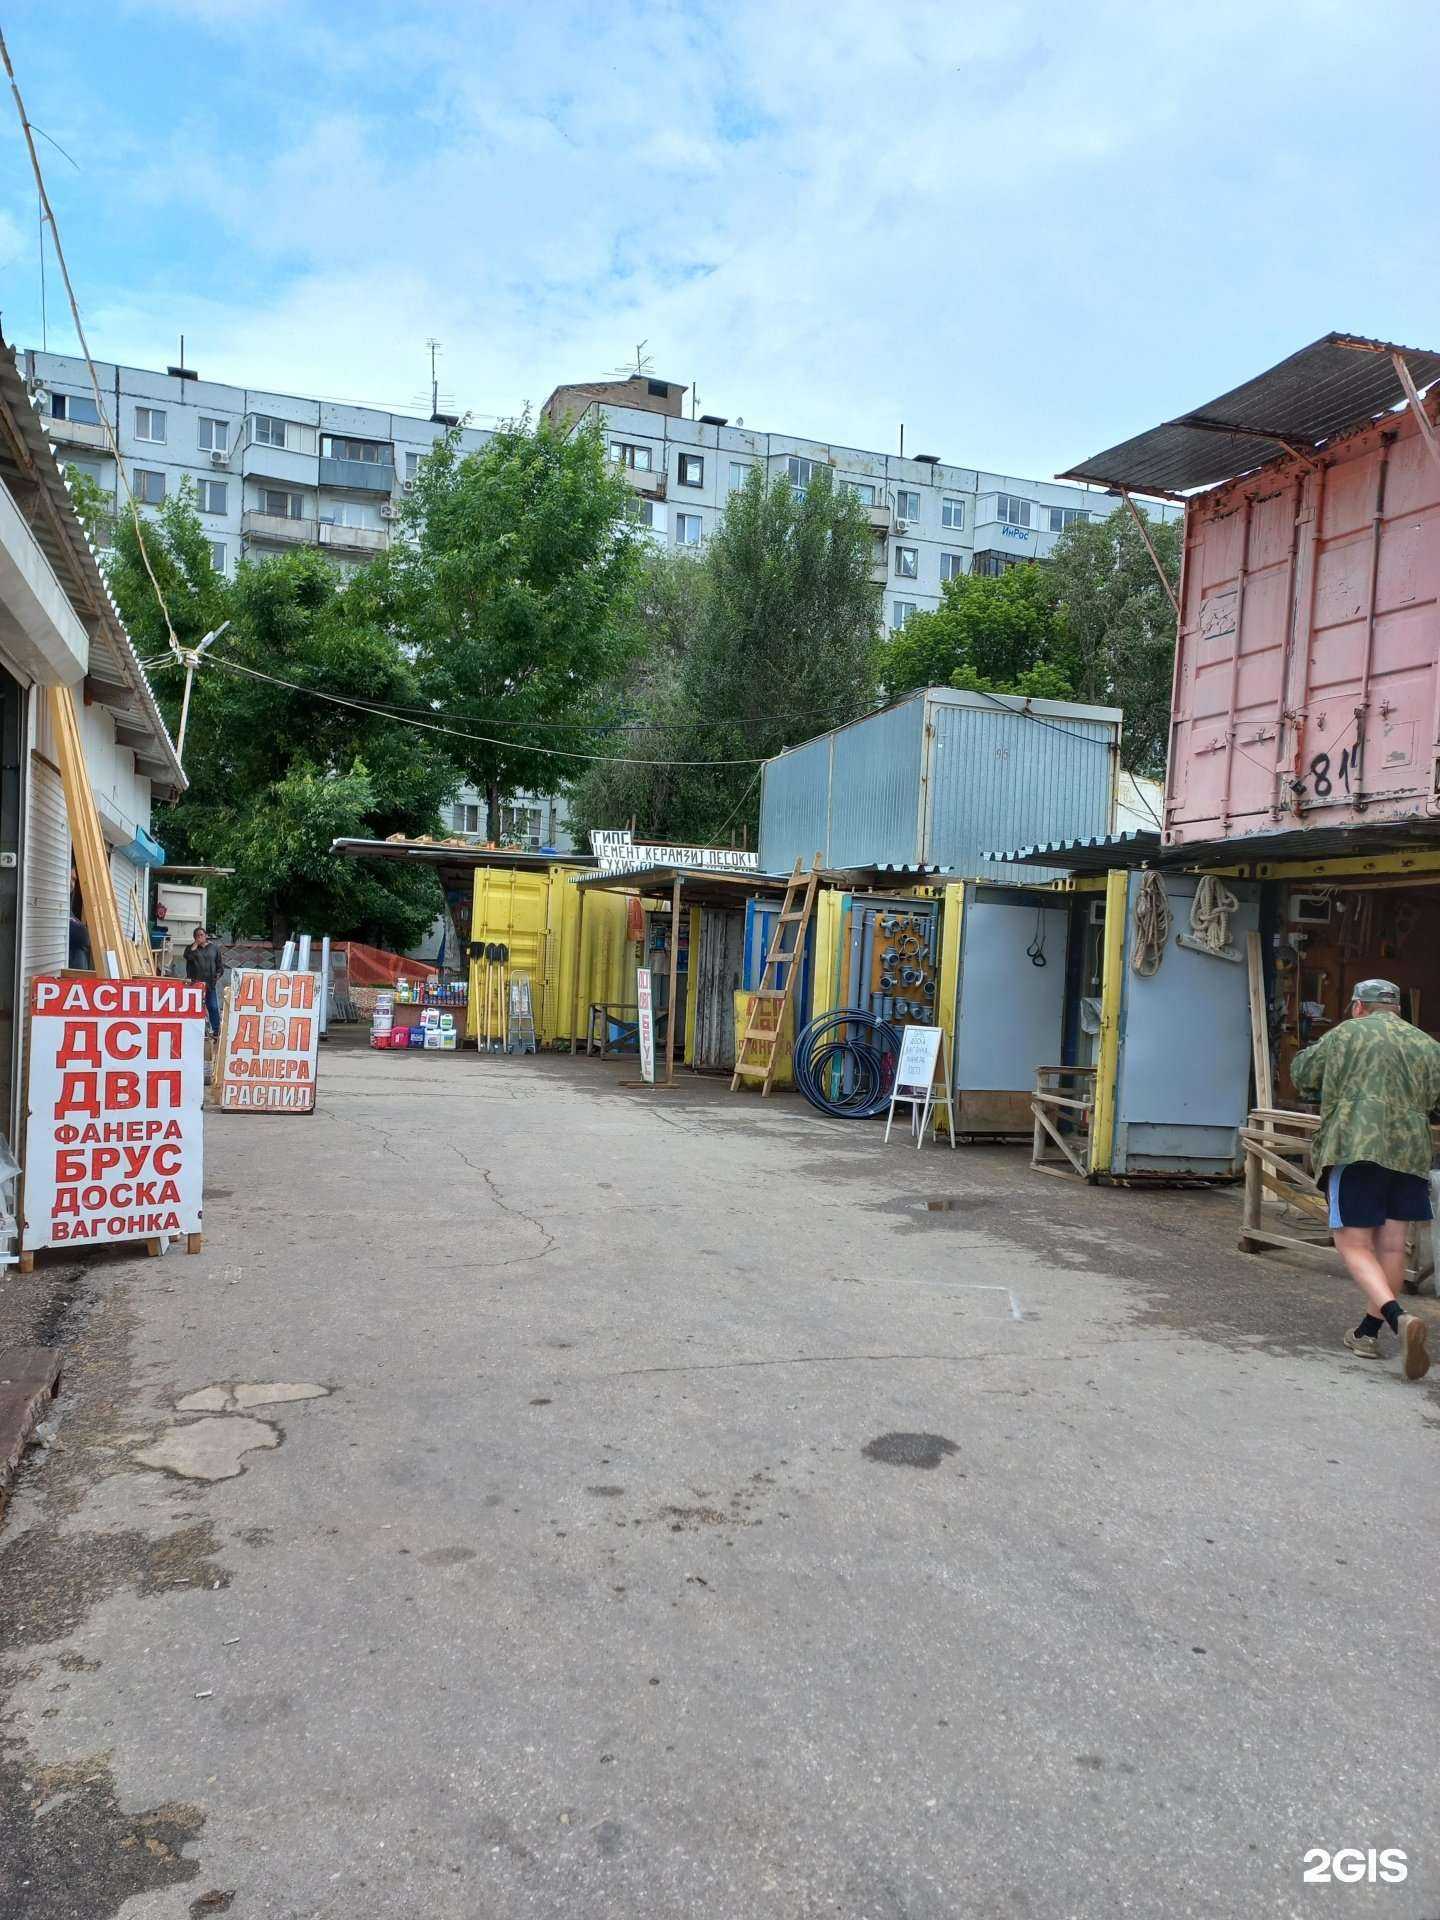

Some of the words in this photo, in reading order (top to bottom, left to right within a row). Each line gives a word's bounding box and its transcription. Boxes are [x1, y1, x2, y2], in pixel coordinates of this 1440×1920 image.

[1002, 525, 1029, 540] ИнРос
[593, 831, 629, 845] ГИПС
[36, 982, 203, 1013] РАСПИЛ
[235, 972, 314, 1012] ДСП
[56, 1021, 184, 1068] ДСП
[231, 1015, 312, 1055] ДВП
[229, 1057, 310, 1079] ФАНЕРА
[54, 1071, 183, 1120] ДВП
[225, 1083, 312, 1107] РАСПИЛ
[54, 1119, 183, 1145] ФАНЕРА
[55, 1143, 183, 1183] БРУС
[51, 1180, 181, 1218] ДОСКА
[51, 1211, 181, 1241] ВАГОНКА
